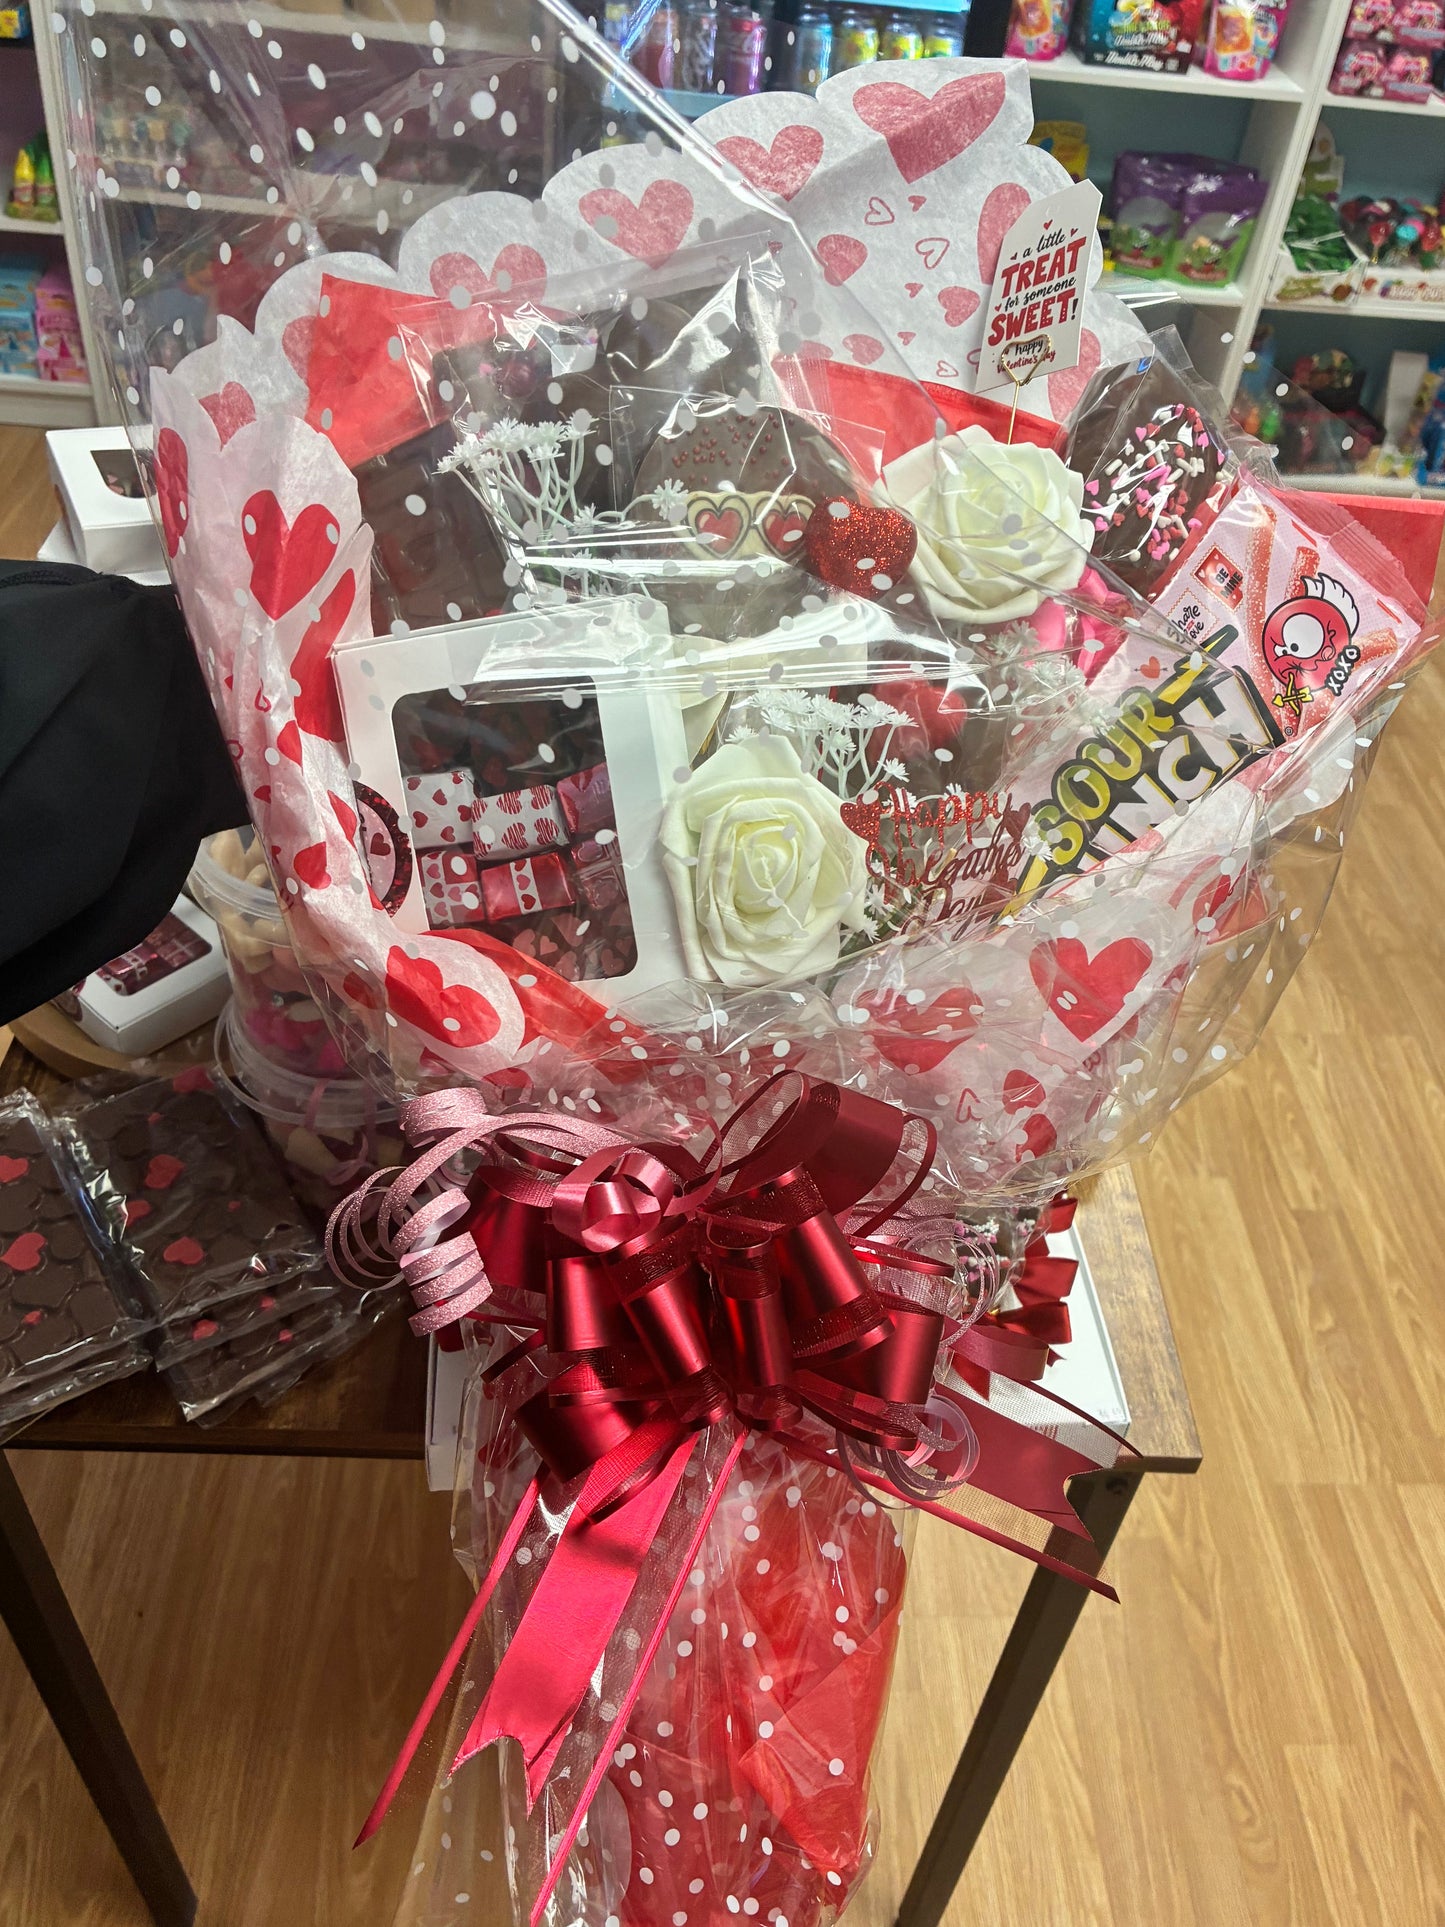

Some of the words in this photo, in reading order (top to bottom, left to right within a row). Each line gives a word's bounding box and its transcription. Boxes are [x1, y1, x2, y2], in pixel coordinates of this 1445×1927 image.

[1022, 247, 1032, 259] a
[1036, 228, 1065, 253] little
[1001, 236, 1087, 298] TREAT
[1005, 294, 1020, 312] for
[1023, 276, 1076, 306] someone
[987, 287, 1079, 347] SWEET!
[1014, 339, 1043, 356] happy
[1215, 568, 1229, 584] BE
[1220, 572, 1243, 598] MINE
[1171, 604, 1201, 631] hare
[1328, 647, 1359, 695] XOXO
[1033, 689, 1175, 866] SOUR
[856, 781, 1012, 850] Happy
